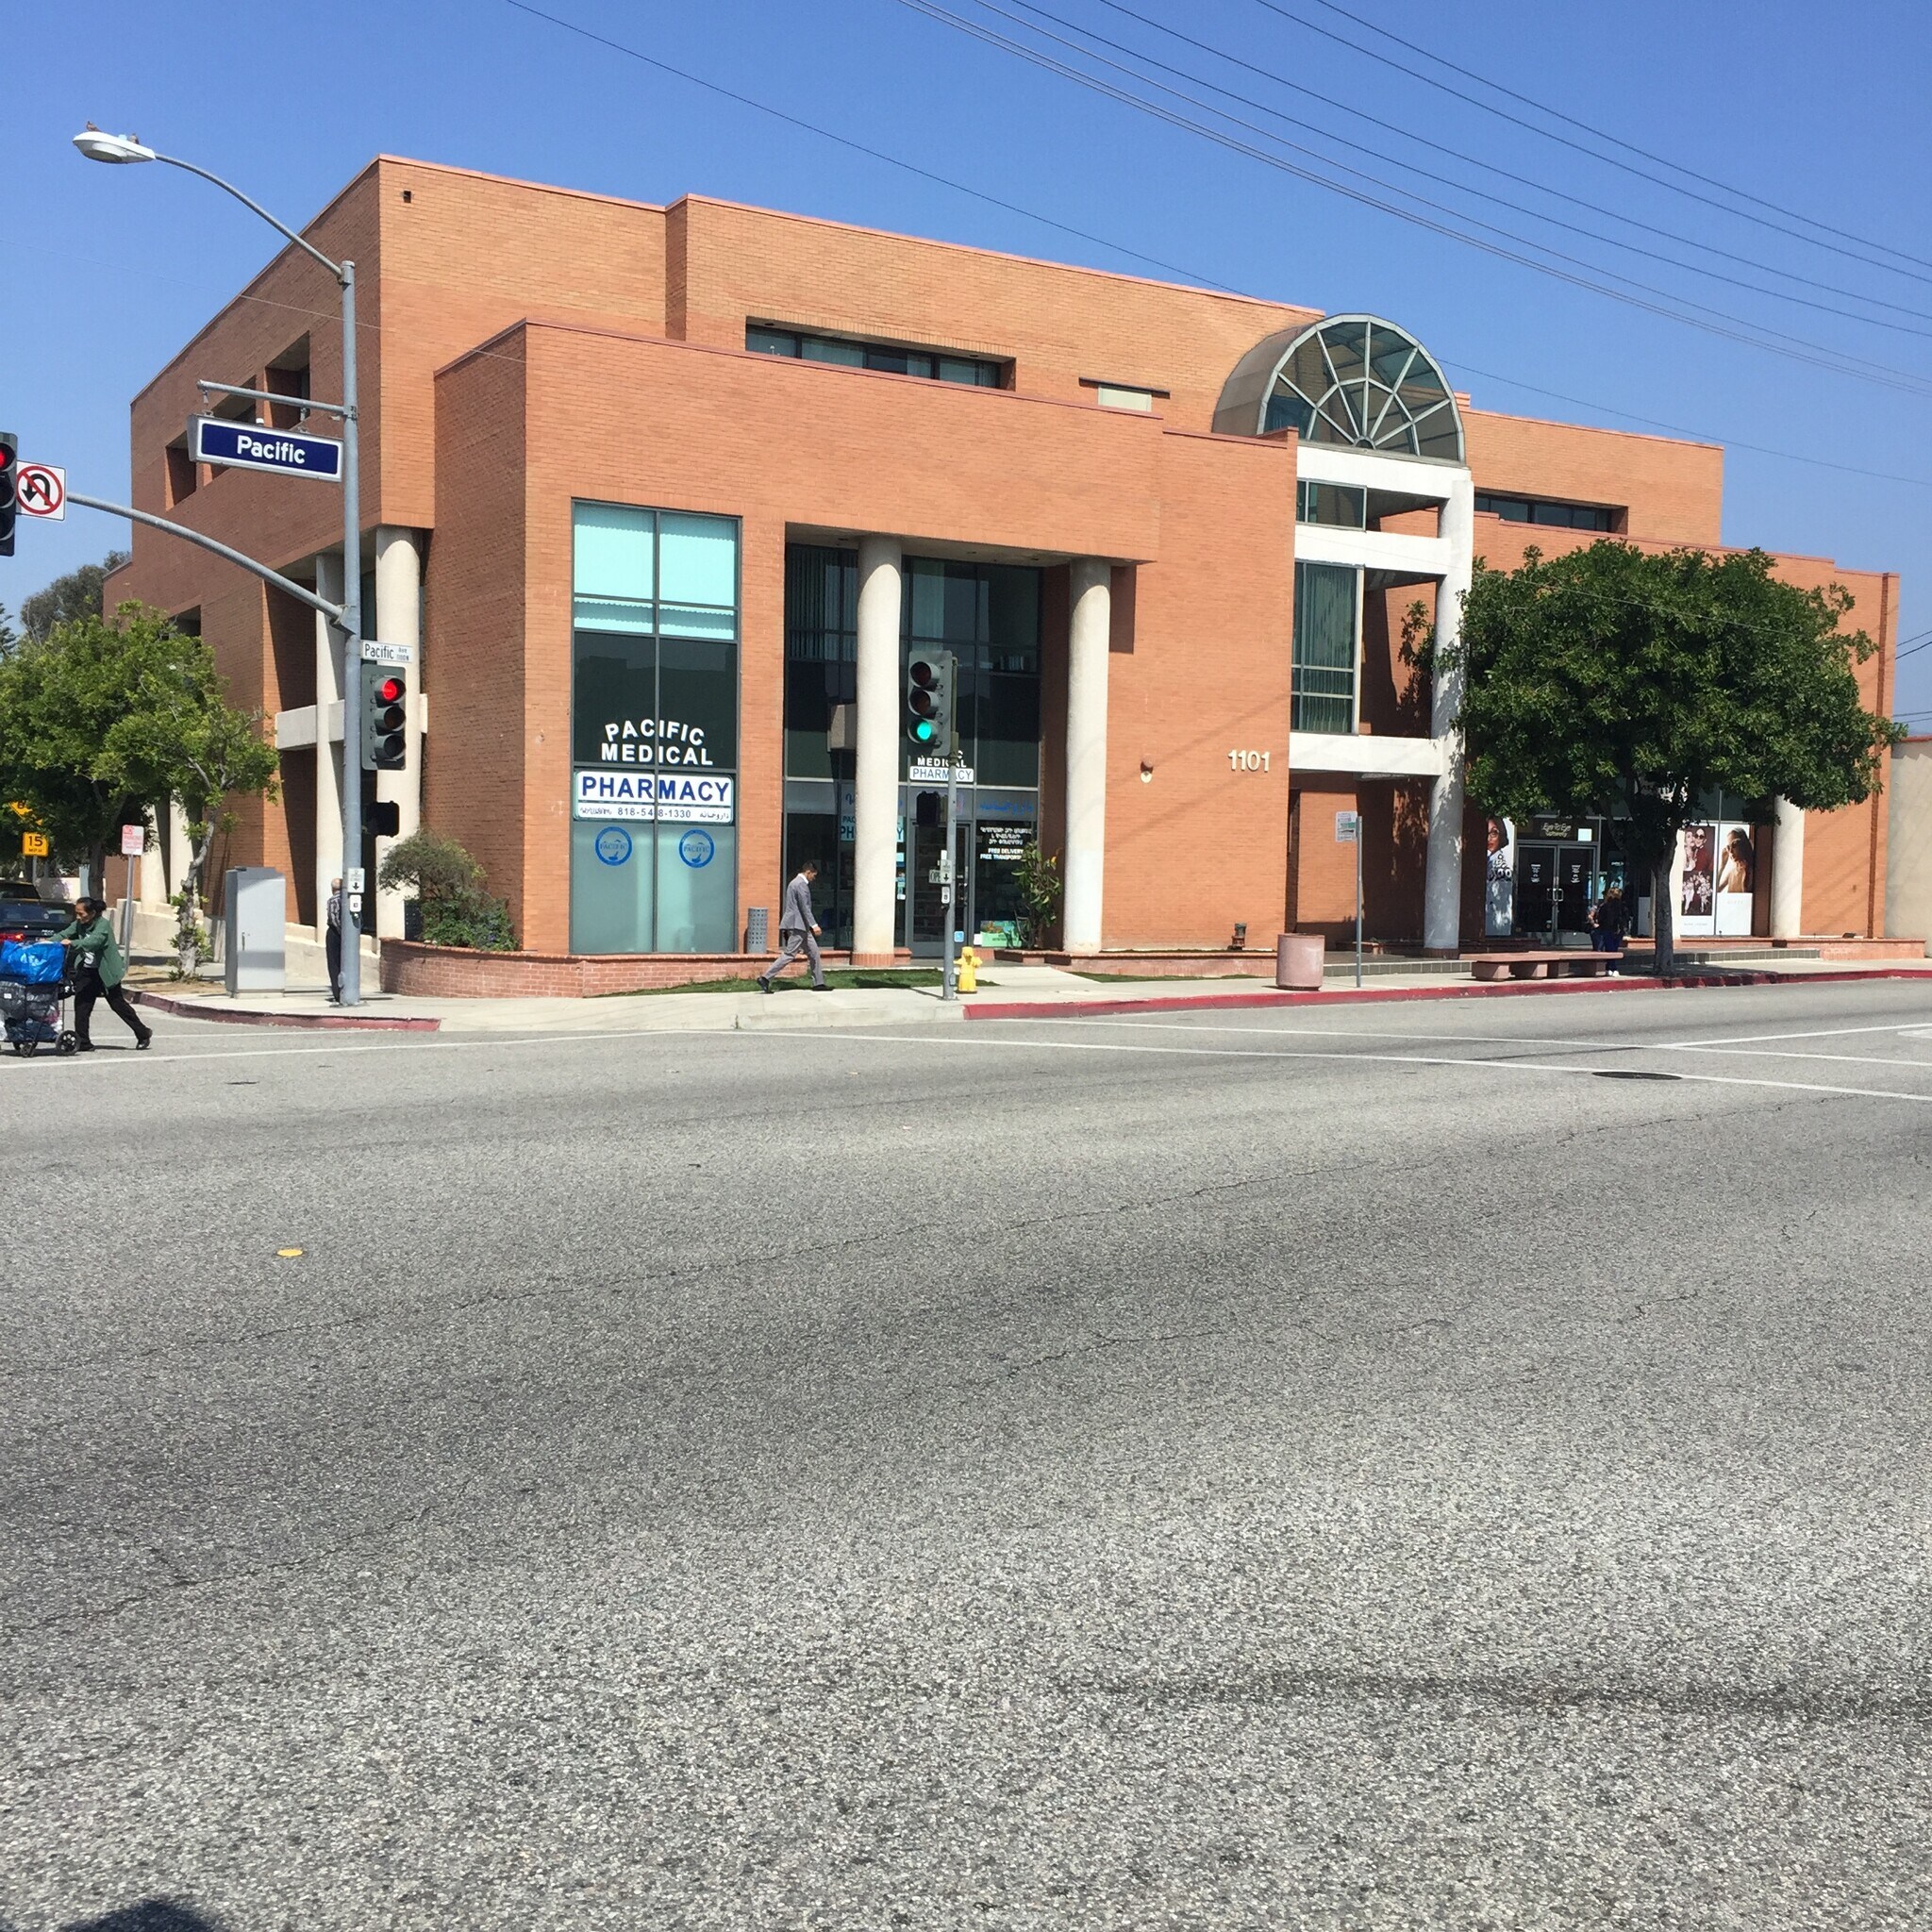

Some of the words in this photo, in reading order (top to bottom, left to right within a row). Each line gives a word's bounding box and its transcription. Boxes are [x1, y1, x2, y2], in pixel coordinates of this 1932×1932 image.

[237, 435, 306, 464] Pacific
[364, 643, 394, 659] Pacific
[605, 719, 705, 745] PACIFIC
[601, 743, 713, 765] MEDICAL
[1227, 749, 1270, 773] 1101
[912, 768, 972, 780] PHARMCY
[582, 775, 729, 802] PHARMACY
[617, 807, 691, 818] 818-548-1330
[28, 836, 43, 847] 15
